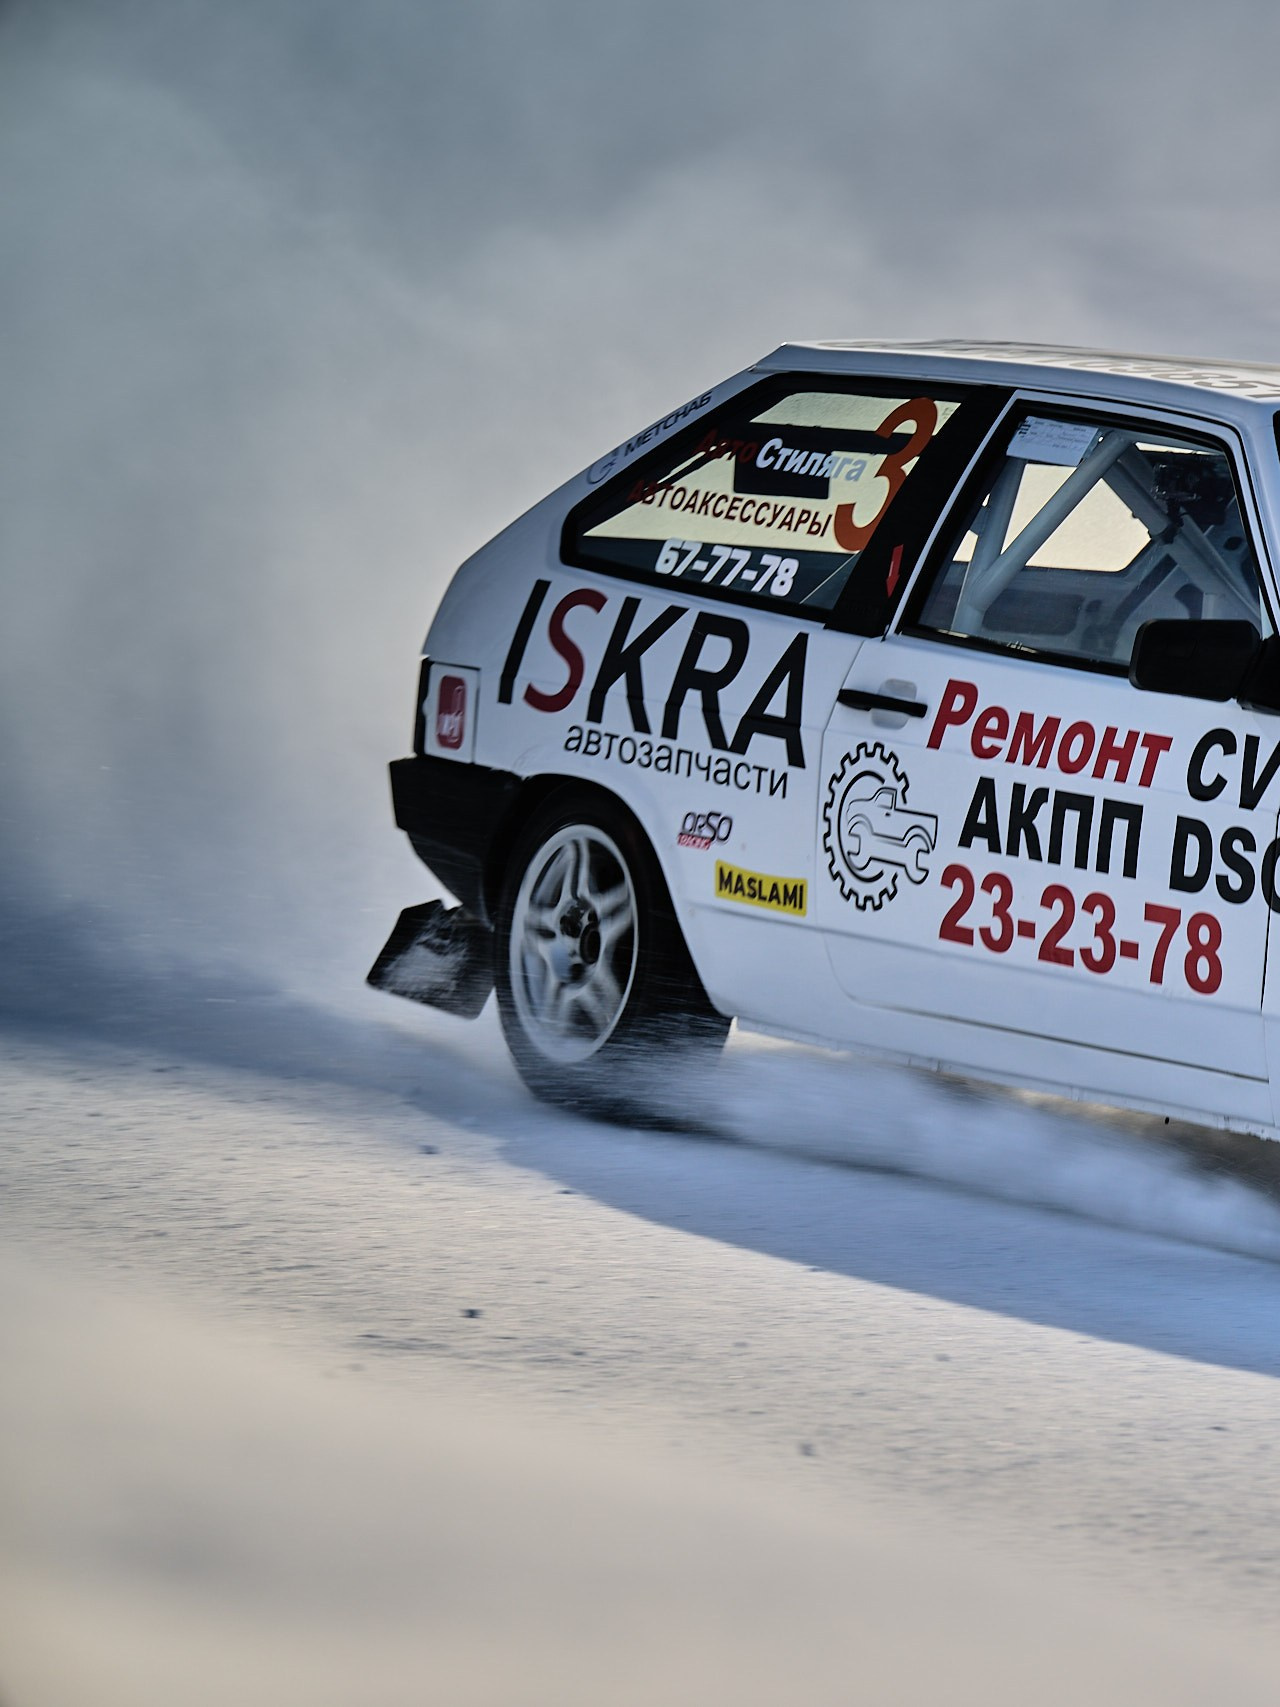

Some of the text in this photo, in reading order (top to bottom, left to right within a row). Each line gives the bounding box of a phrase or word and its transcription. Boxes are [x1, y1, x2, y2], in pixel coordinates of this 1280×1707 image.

[626, 479, 834, 538] АВТОАКСЕССУАРЫ
[834, 397, 938, 552] 3
[655, 538, 799, 597] 67-77-78
[497, 579, 810, 769] ISKRA
[564, 725, 789, 798] автозапчасти
[926, 679, 1173, 787] Ремонт
[958, 777, 1143, 879] АКПП
[718, 866, 804, 910] MASLAMI
[939, 864, 1222, 994] 23-23-78
